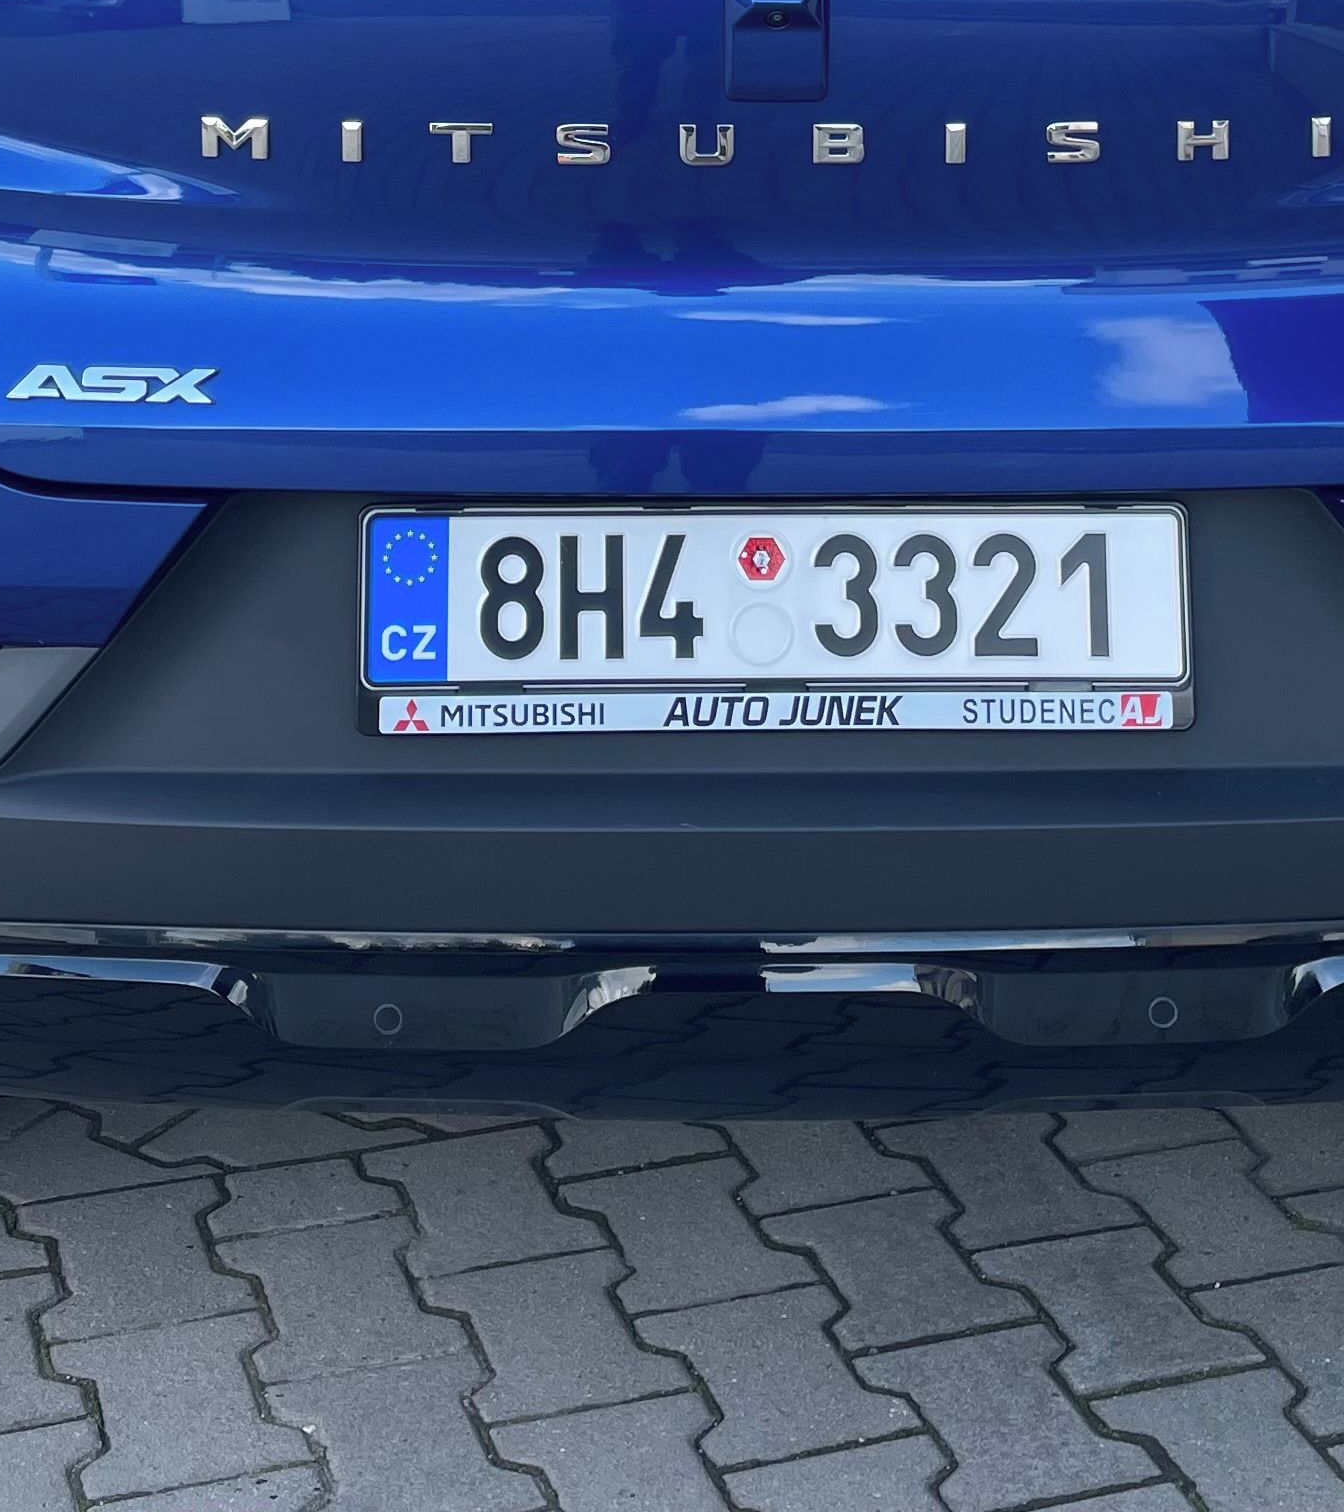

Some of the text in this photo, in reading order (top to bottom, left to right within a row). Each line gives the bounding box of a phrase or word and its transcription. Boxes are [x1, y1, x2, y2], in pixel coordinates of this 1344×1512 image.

[200, 115, 1332, 167] MITSUBISHI
[6, 363, 220, 405] ASX
[479, 533, 1112, 659] 8H4 3321
[380, 625, 437, 660] CZ
[440, 703, 606, 726] MITSUBISHI
[663, 697, 771, 727] AUTO
[778, 696, 904, 726] JUNEK
[962, 699, 1115, 724] STUDENEC
